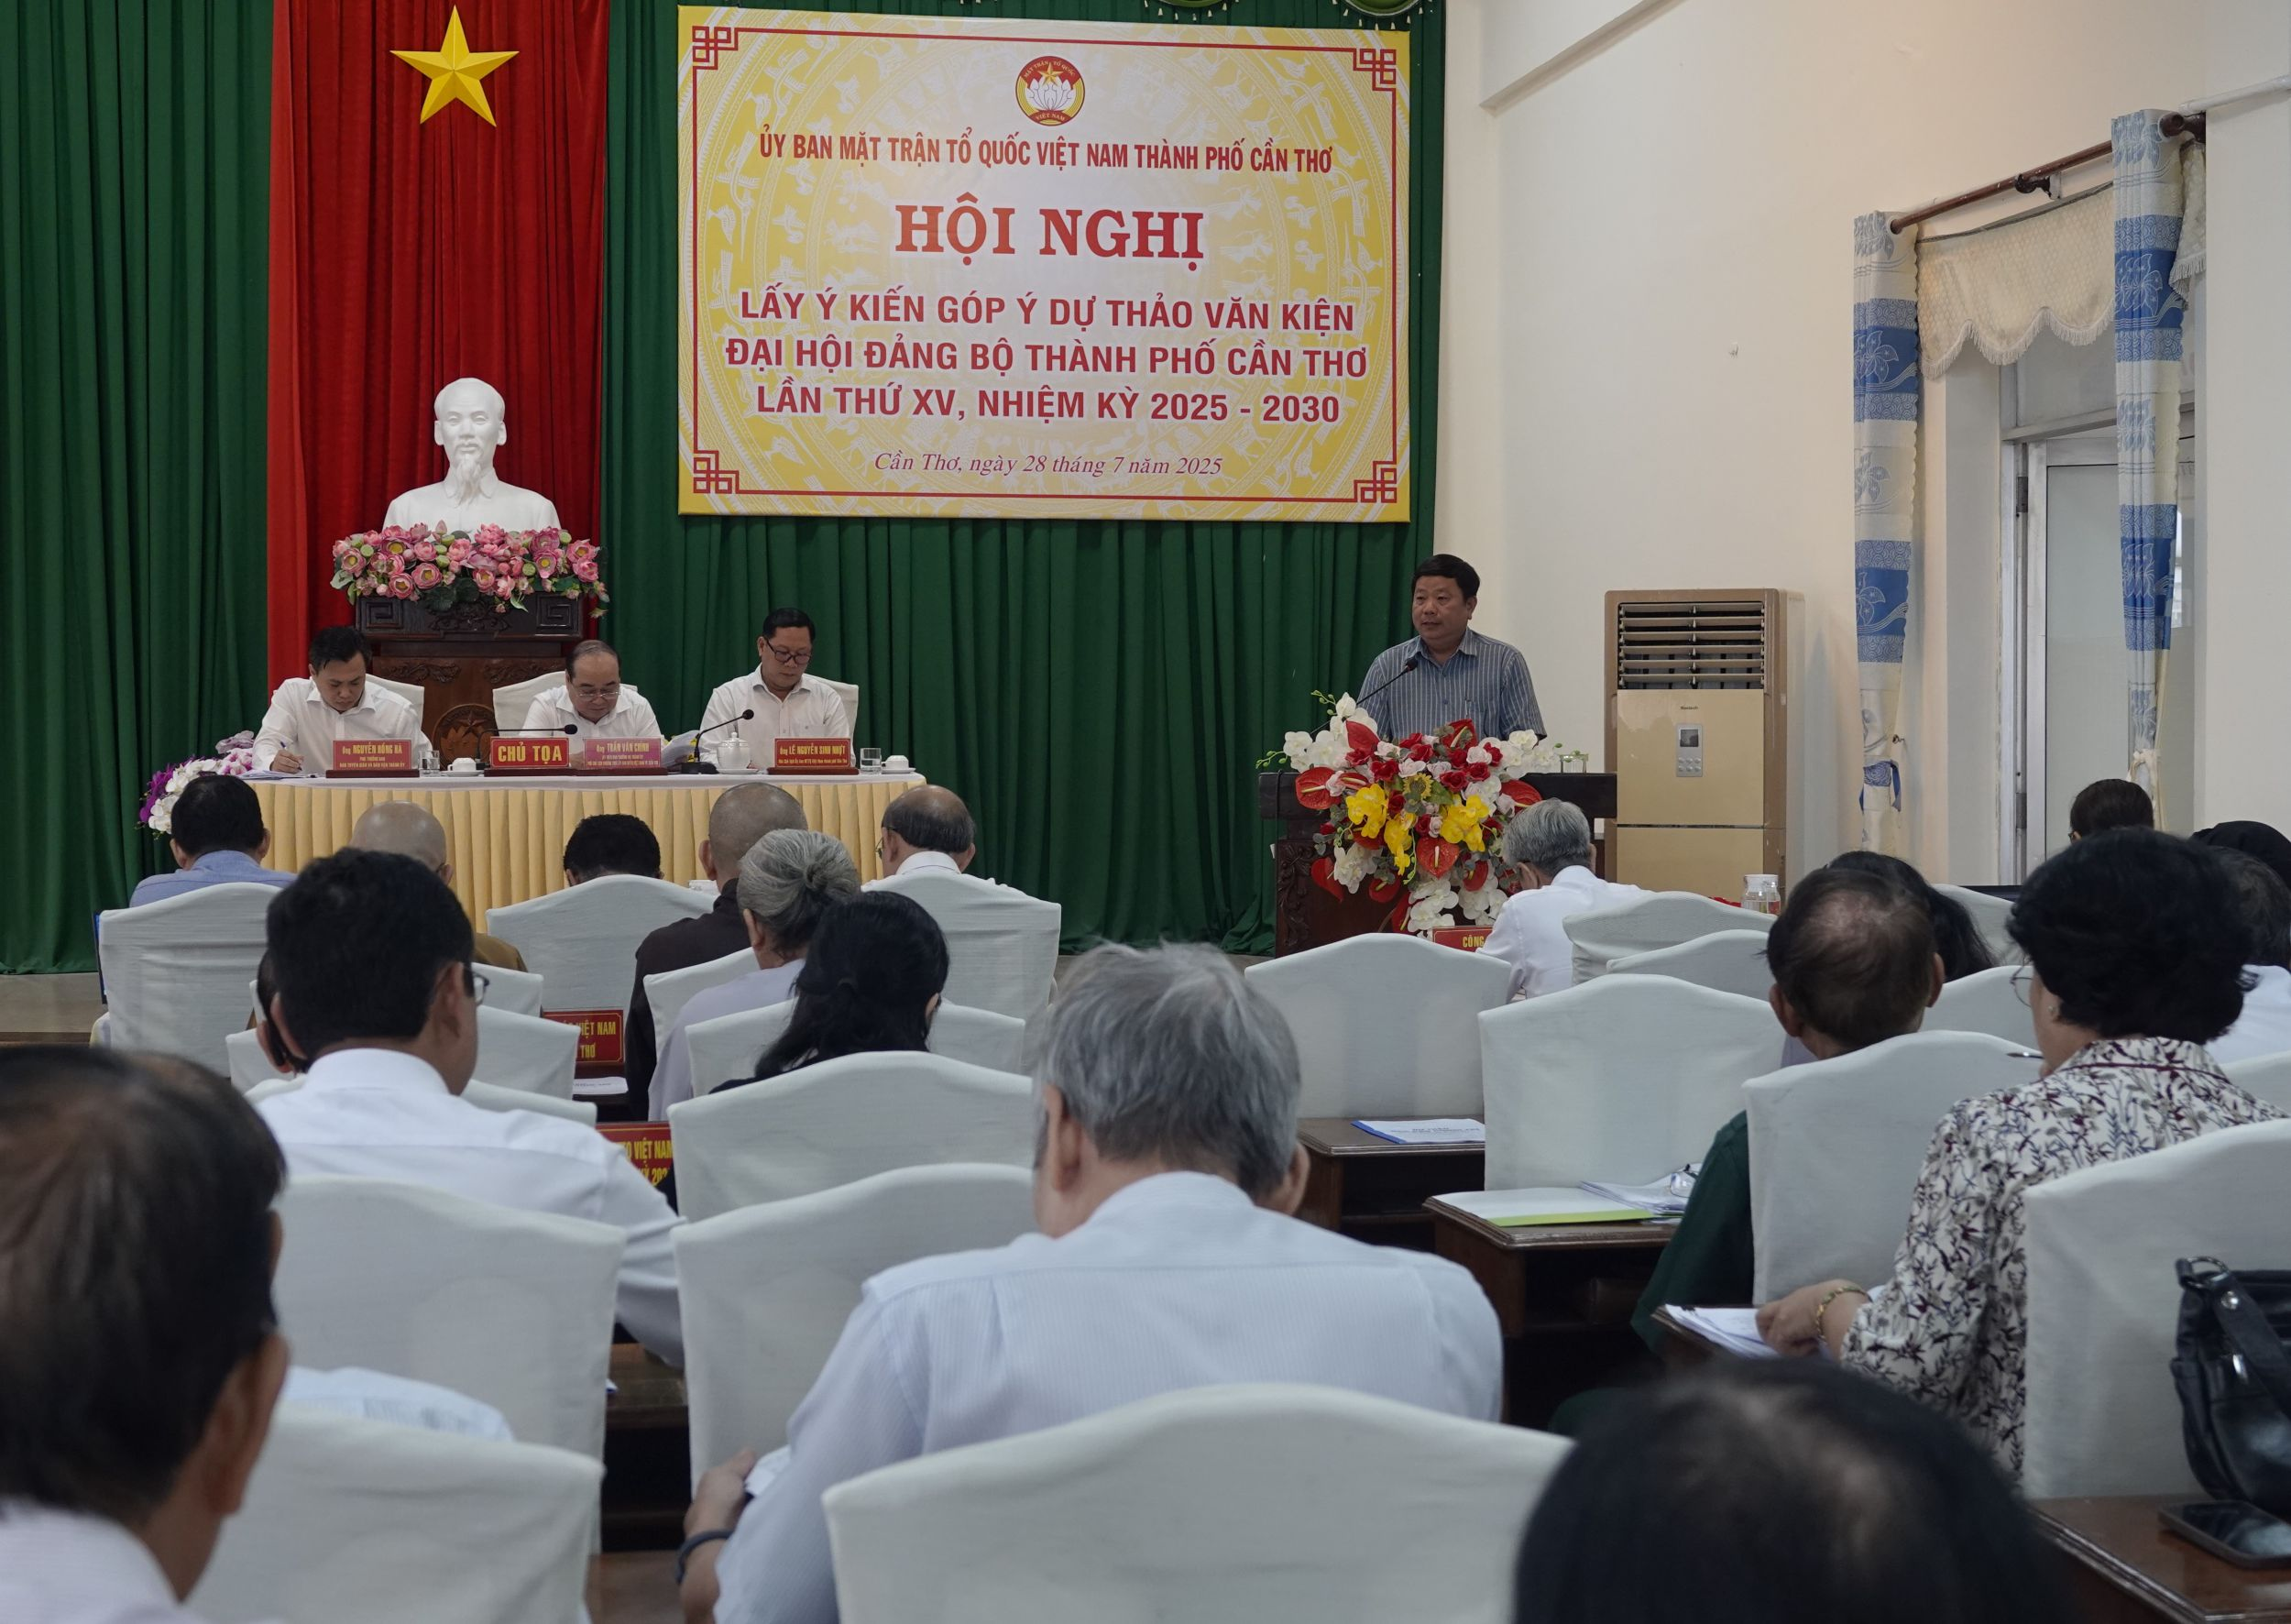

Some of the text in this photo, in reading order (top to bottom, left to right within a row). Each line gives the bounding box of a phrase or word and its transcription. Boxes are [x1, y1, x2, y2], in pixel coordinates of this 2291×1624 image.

[760, 123, 1333, 174] ỦY BAN MẶT TRẬN TỔ QUỐC VIỆT NAM THÀNH PHỐ CẦN THƠ
[895, 192, 1204, 272] HỘI NGHỊ
[741, 282, 1354, 336] LẤY Ý KIẾN GÓP Ý DỰ THẢO VĂN KIỆN
[725, 333, 1366, 378] ĐẠI HỘI ĐẢNG BỘ THÀNH PHỐ CẦN THƠ
[758, 376, 821, 413] LẦN
[833, 381, 903, 415] THỨ
[913, 390, 965, 421] XV,
[979, 384, 1084, 424] NHIỆM
[1098, 386, 1139, 419] KỲ
[1151, 392, 1228, 422] 2025
[1263, 395, 1340, 422] 2030
[874, 452, 1223, 478] Cần Thơ, ngày 28 tháng 7 năm 2025
[498, 741, 563, 765] CHỦ TỌA
[1463, 935, 1485, 948] CÔNG
[597, 1021, 617, 1036] NAM
[580, 1042, 596, 1059] THƠ
[634, 1136, 652, 1164] VIỆT
